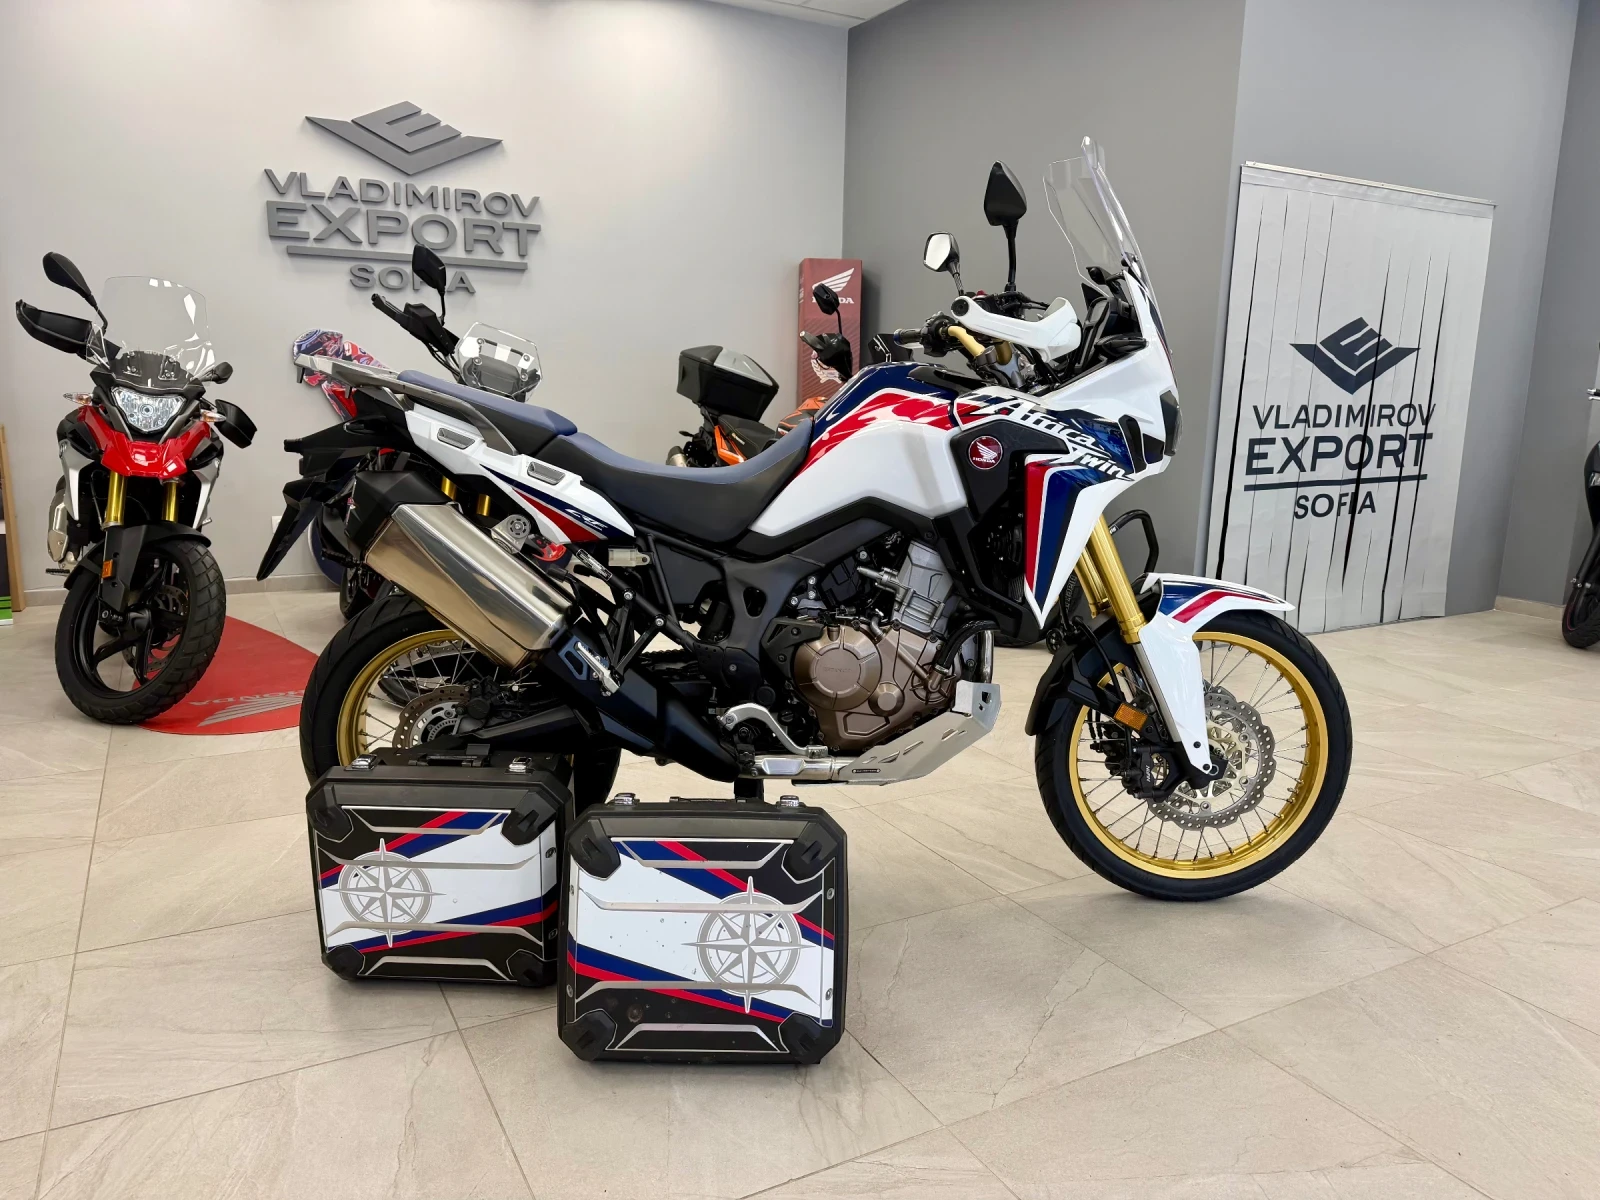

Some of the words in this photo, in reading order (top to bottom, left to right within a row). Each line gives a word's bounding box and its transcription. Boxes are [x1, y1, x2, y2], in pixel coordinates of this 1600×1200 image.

[264, 168, 540, 217] VLADIMIROV
[266, 200, 541, 256] EXPORT
[350, 264, 477, 294] SOA
[970, 398, 1105, 452] Africa
[1252, 403, 1436, 429] VLADIMIROV
[973, 456, 996, 464] HONDA
[1050, 439, 1134, 481] Twin
[1245, 433, 1433, 476] EXPORT
[1294, 490, 1377, 519] SOFIA
